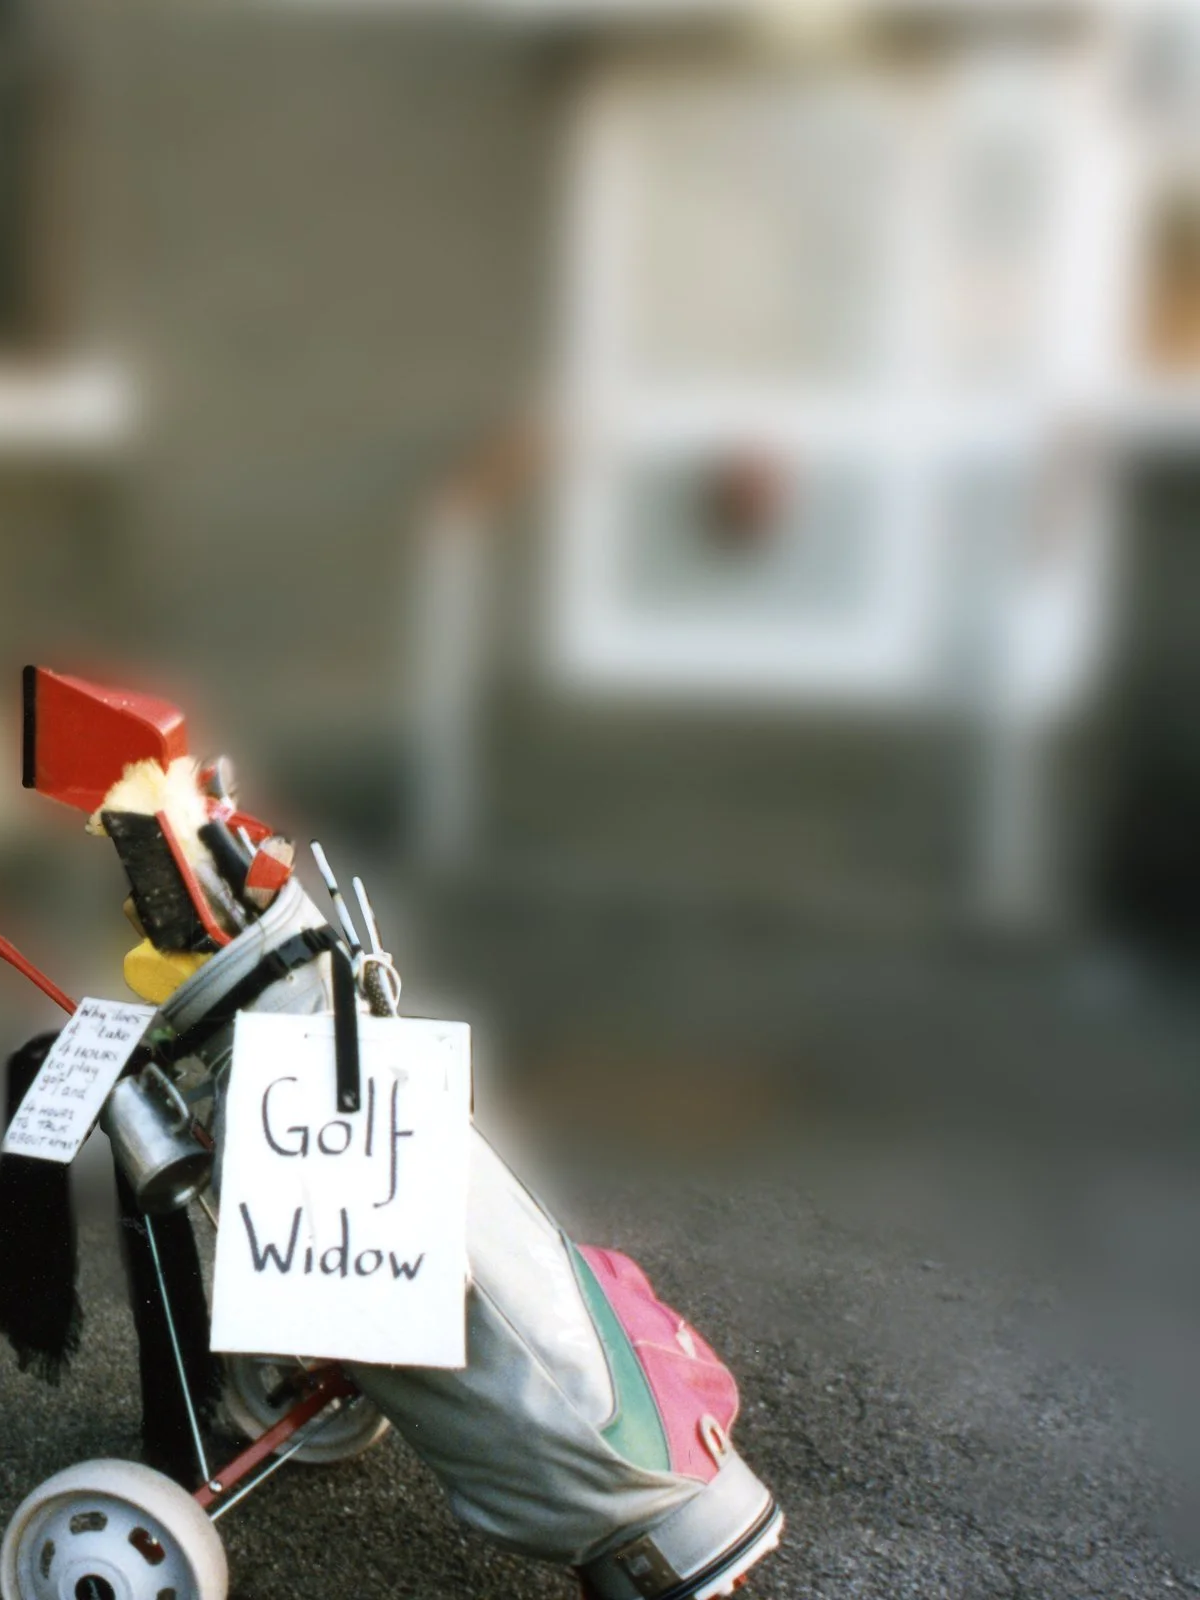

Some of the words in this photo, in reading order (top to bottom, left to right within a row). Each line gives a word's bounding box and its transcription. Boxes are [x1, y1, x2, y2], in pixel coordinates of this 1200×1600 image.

[80, 1004, 106, 1021] Why
[97, 1023, 131, 1042] take
[66, 1061, 100, 1084] play
[261, 1076, 414, 1208] Golf
[239, 1202, 426, 1281] Widow
